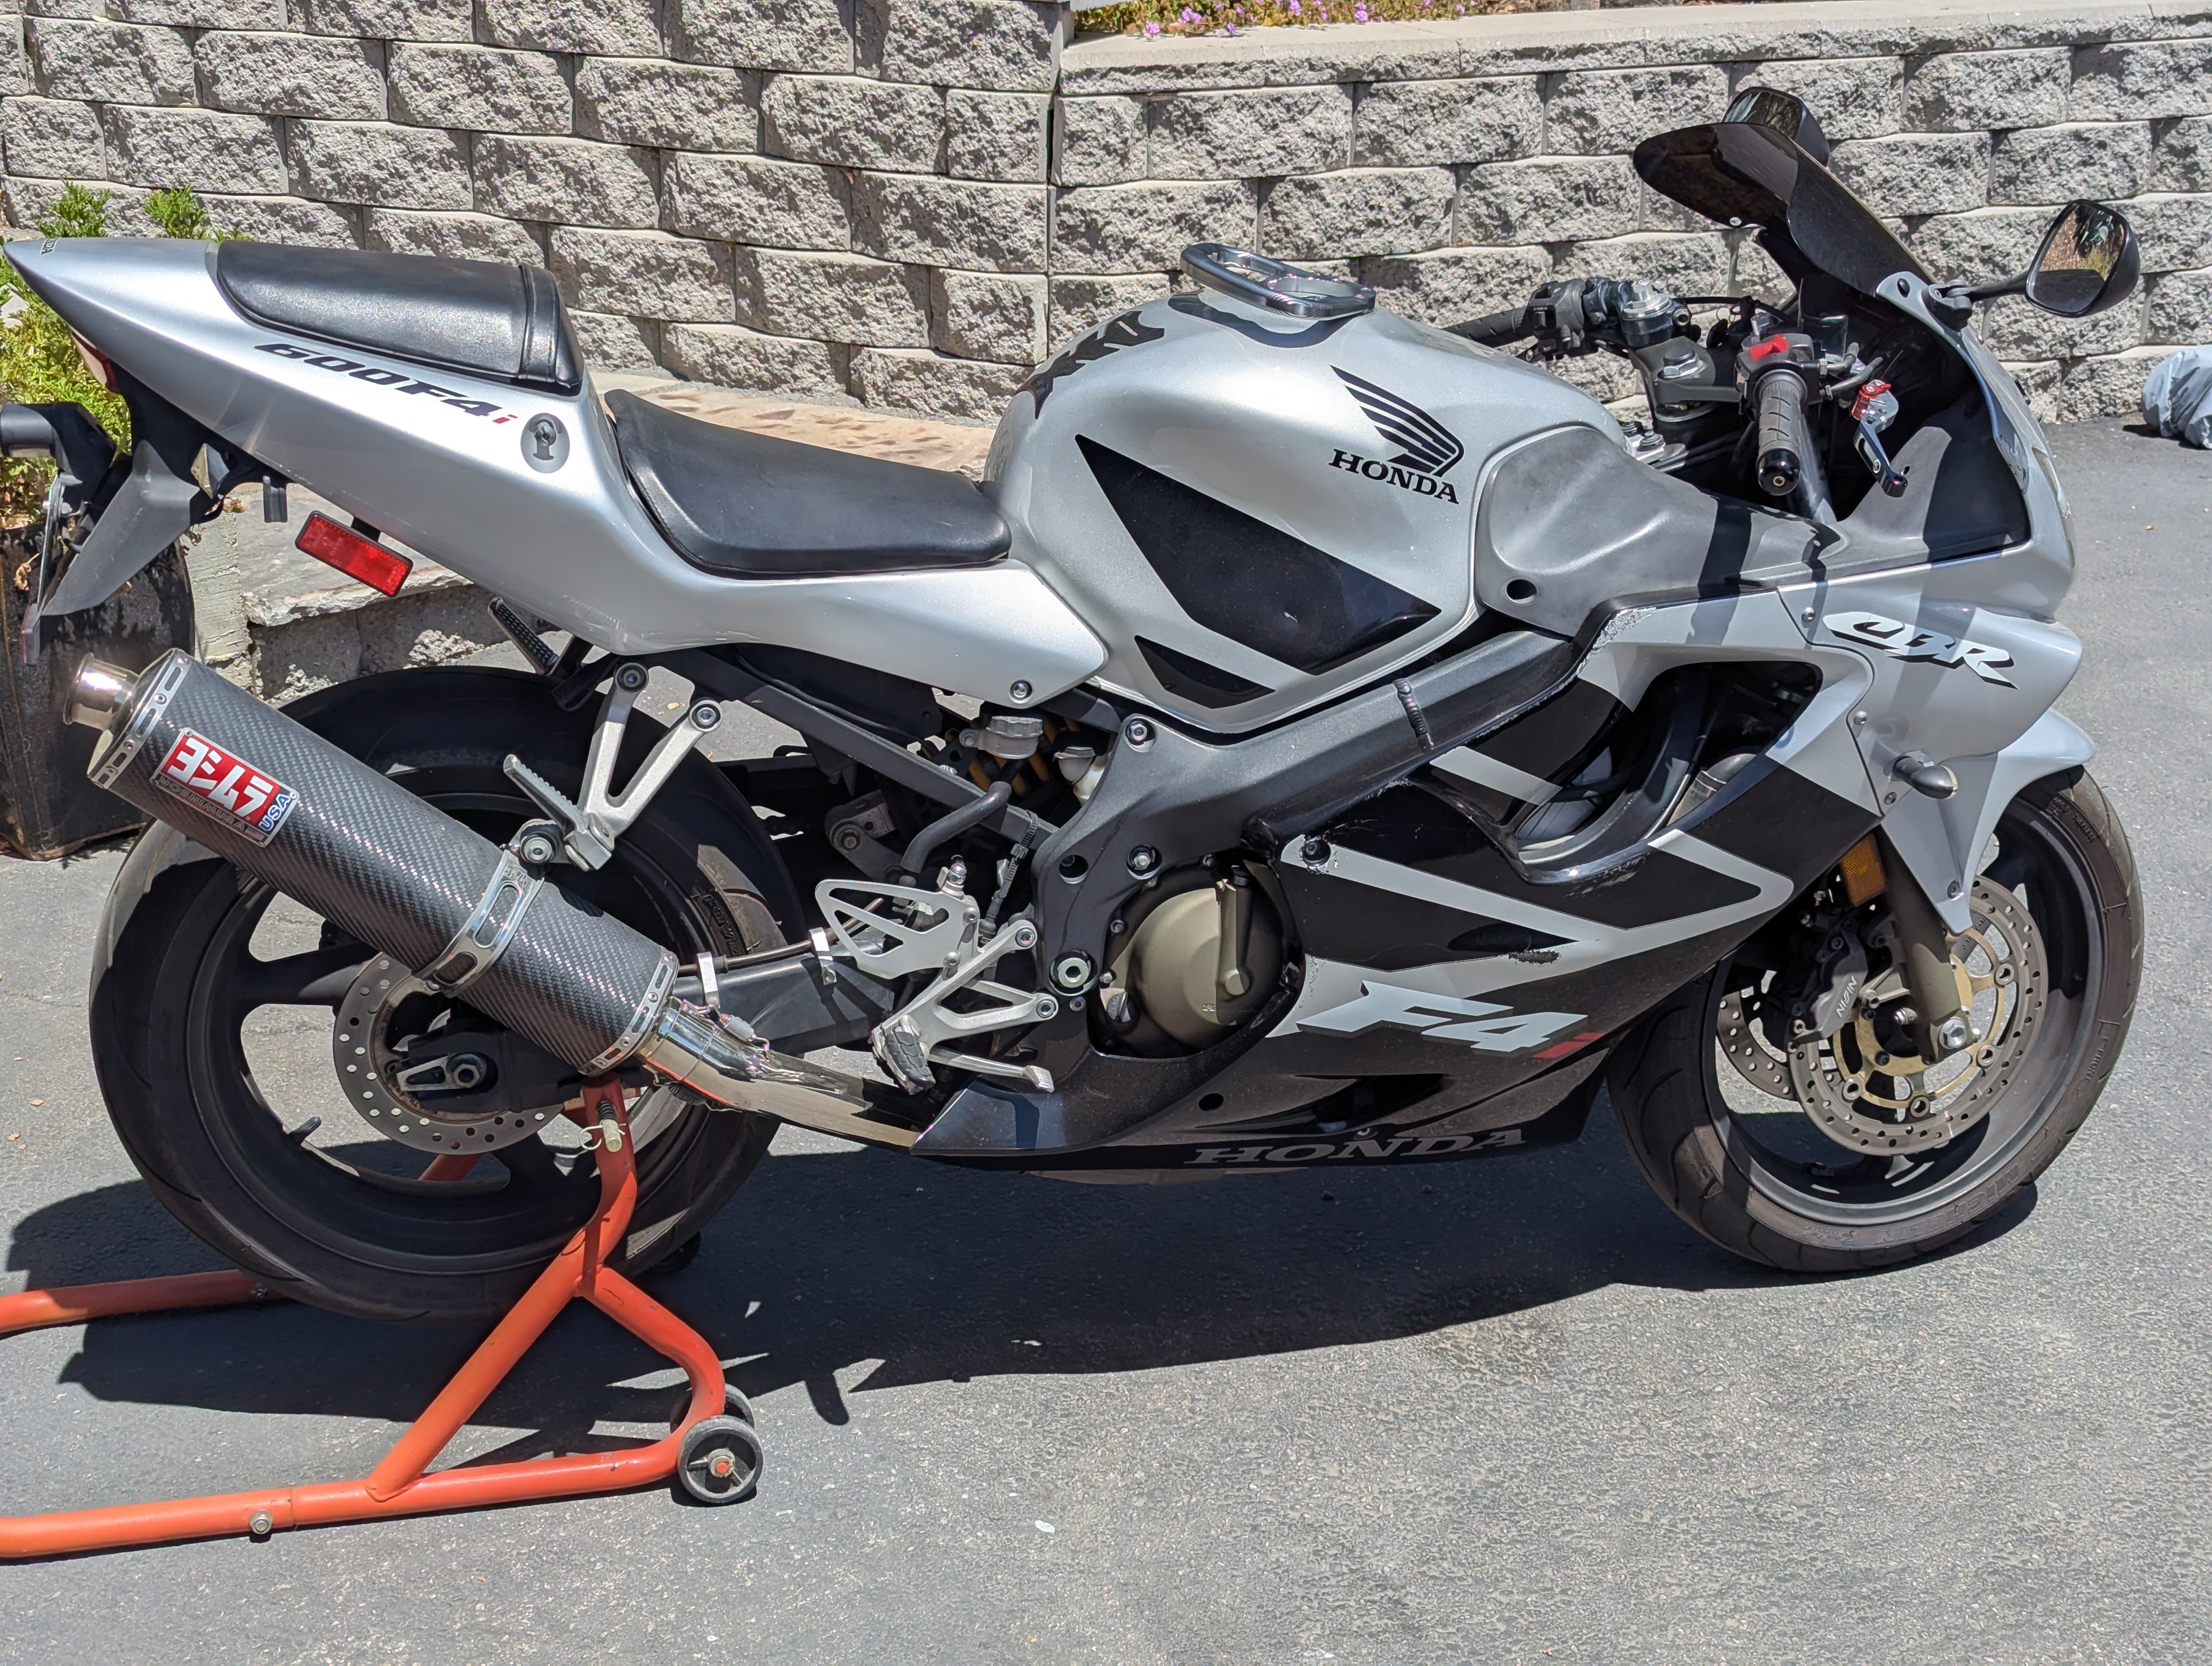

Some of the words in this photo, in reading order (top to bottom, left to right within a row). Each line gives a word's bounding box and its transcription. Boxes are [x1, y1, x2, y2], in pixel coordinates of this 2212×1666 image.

[254, 343, 518, 424] 600F4i
[1328, 449, 1459, 504] HONDA
[1823, 612, 2018, 690] CBR
[158, 776, 245, 831] YOSHIMURA
[167, 738, 273, 817] ヨシムラ
[258, 793, 291, 831] USA
[1296, 980, 1606, 1059] F4i
[1836, 976, 1857, 1018] NISSIN
[2084, 1048, 2104, 1081] FRONT
[1183, 1129, 1526, 1164] HONDA
[1875, 1164, 2020, 1245] MICHELIN
